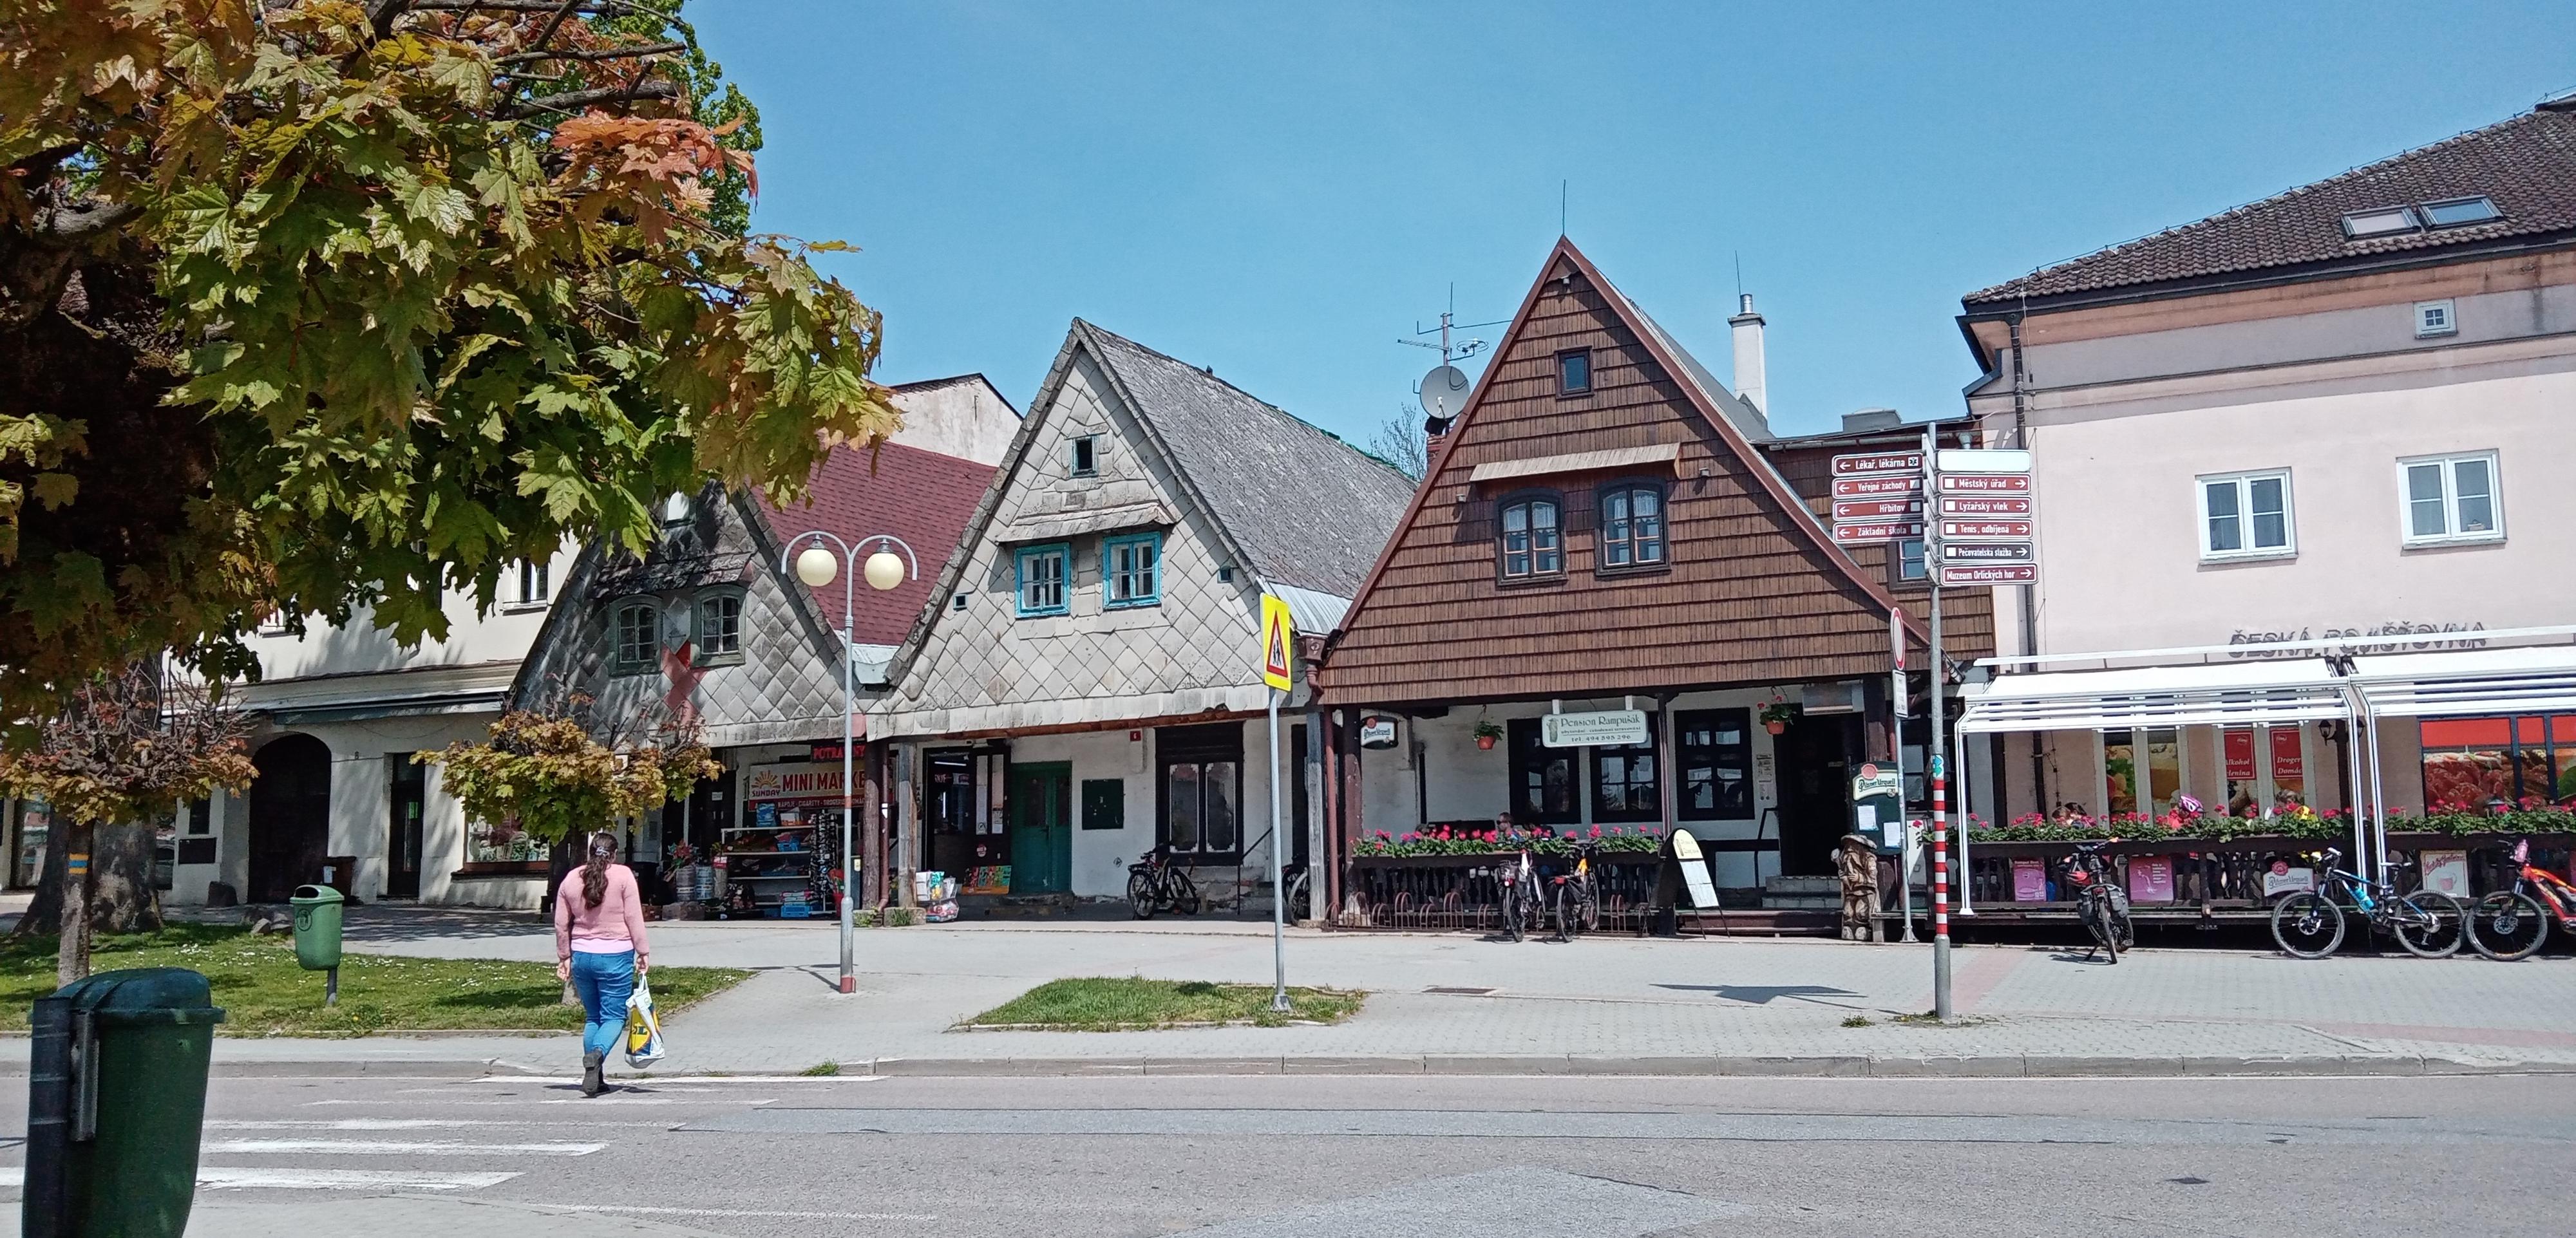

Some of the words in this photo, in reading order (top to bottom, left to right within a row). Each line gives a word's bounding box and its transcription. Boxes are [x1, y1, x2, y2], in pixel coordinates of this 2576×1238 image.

[1879, 458, 1906, 468] lékárna
[1857, 483, 1879, 492] Veřejné
[1882, 481, 1906, 491] záchody
[1959, 478, 1988, 489] Městský
[1991, 478, 2006, 488] úřad
[1879, 504, 1905, 513] Hřbitov
[1959, 502, 1991, 512] Lyžařský
[1993, 502, 2008, 511] vlek
[1857, 527, 1886, 536] Základní
[1888, 526, 1906, 534] škola
[1982, 524, 2009, 534] odbíjená
[1958, 548, 1993, 557] Pečovatelská
[1994, 548, 2012, 557] služba
[1947, 571, 1972, 580] Muzeum
[1974, 570, 2002, 581] Orlických
[2005, 570, 2015, 579] hor
[2228, 627, 2313, 658] ČESKÁ
[1560, 718, 1596, 727] Pension
[1598, 715, 1640, 727] Rampušák
[813, 746, 866, 760] POTRANY
[782, 773, 813, 793] MINI
[817, 769, 865, 790] MARKE
[1859, 779, 1877, 792] Pilsner
